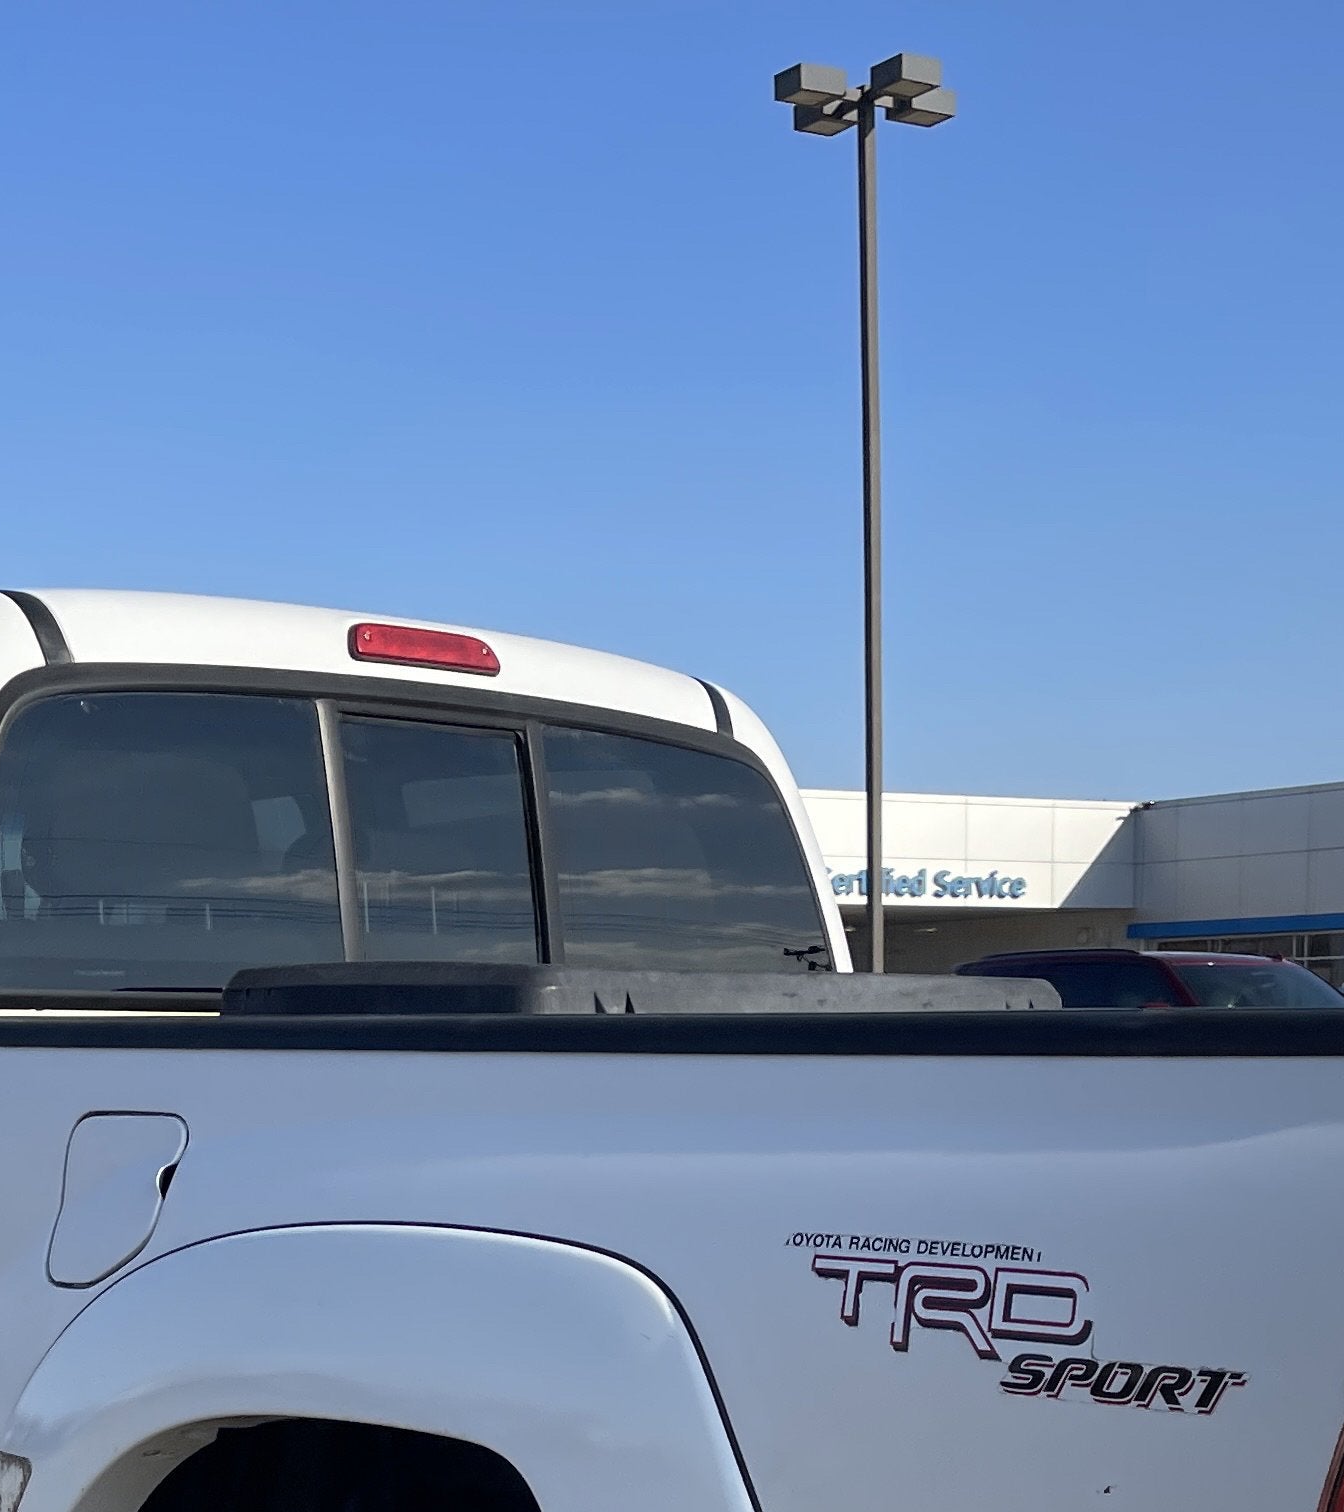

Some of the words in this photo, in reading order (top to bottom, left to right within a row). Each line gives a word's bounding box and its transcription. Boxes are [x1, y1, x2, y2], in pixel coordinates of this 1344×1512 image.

[932, 869, 1027, 899] Service
[848, 1235, 911, 1255] RACING
[812, 1254, 1093, 1363] TRD
[1000, 1353, 1247, 1414] SPORT
